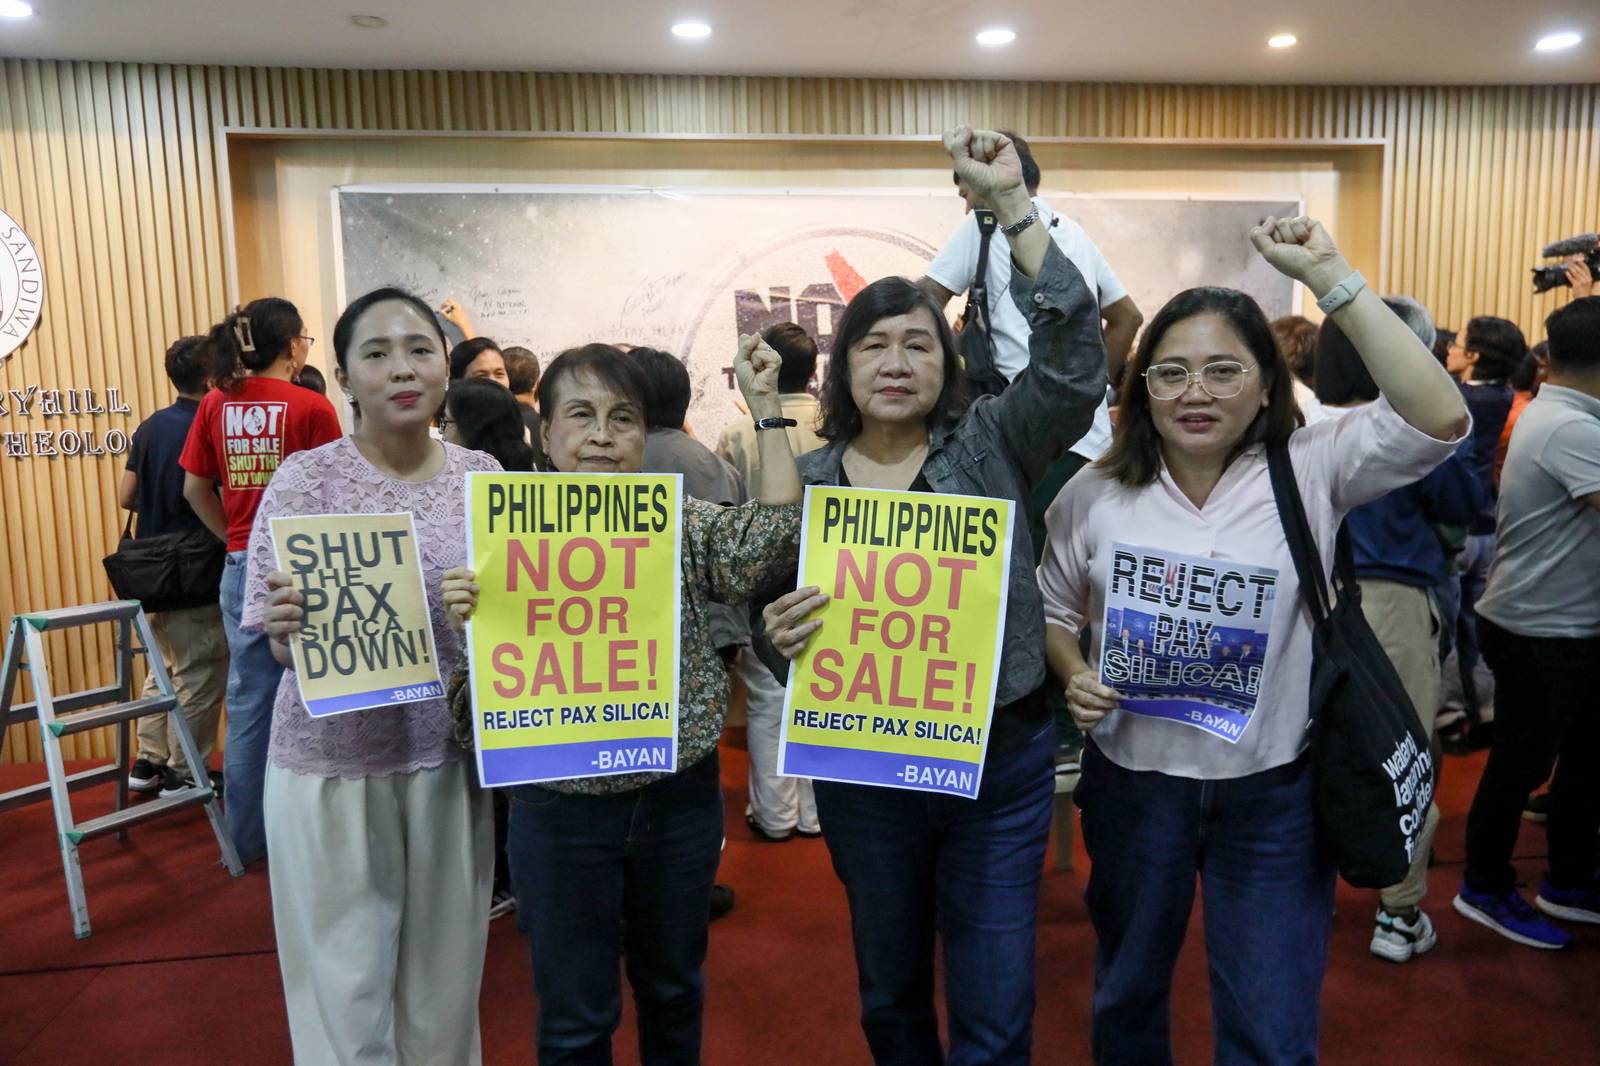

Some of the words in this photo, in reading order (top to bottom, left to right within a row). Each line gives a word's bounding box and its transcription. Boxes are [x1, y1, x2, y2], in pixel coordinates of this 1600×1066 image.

[2, 227, 39, 337] SANDIWA
[226, 406, 282, 436] NOT
[4, 429, 134, 457] HEOLO
[227, 438, 250, 454] FOR
[252, 437, 279, 453] SALE
[229, 454, 257, 471] SHUT
[259, 454, 279, 470] THE
[231, 472, 248, 486] PAX
[488, 483, 668, 533] PHILIPPINES
[823, 496, 998, 557] PHILIPPINES
[286, 530, 408, 572] SHUT
[506, 537, 650, 592] NOT
[292, 567, 364, 589] THE
[833, 548, 977, 610] NOT
[1111, 550, 1276, 619] REJECT
[299, 582, 399, 626] PAX
[527, 597, 628, 636] FOR
[301, 616, 404, 642] SILICA
[850, 608, 951, 653] FOR
[1153, 612, 1214, 659] PAX
[302, 629, 430, 680] DOWN!
[491, 639, 657, 699] SALE!
[1104, 649, 1262, 695] SILICA!
[391, 684, 442, 702] -BAYAN
[809, 648, 976, 714] SALE!
[483, 708, 554, 730] REJECT
[561, 706, 596, 725] PAX
[602, 702, 669, 722] SILICA!
[793, 709, 867, 732] REJECT
[872, 717, 910, 736] PAX
[914, 720, 982, 745] SILICA!
[1184, 710, 1241, 737] -BAYAN
[591, 748, 666, 769] -BAYAN
[896, 765, 973, 791] -BAYAN
